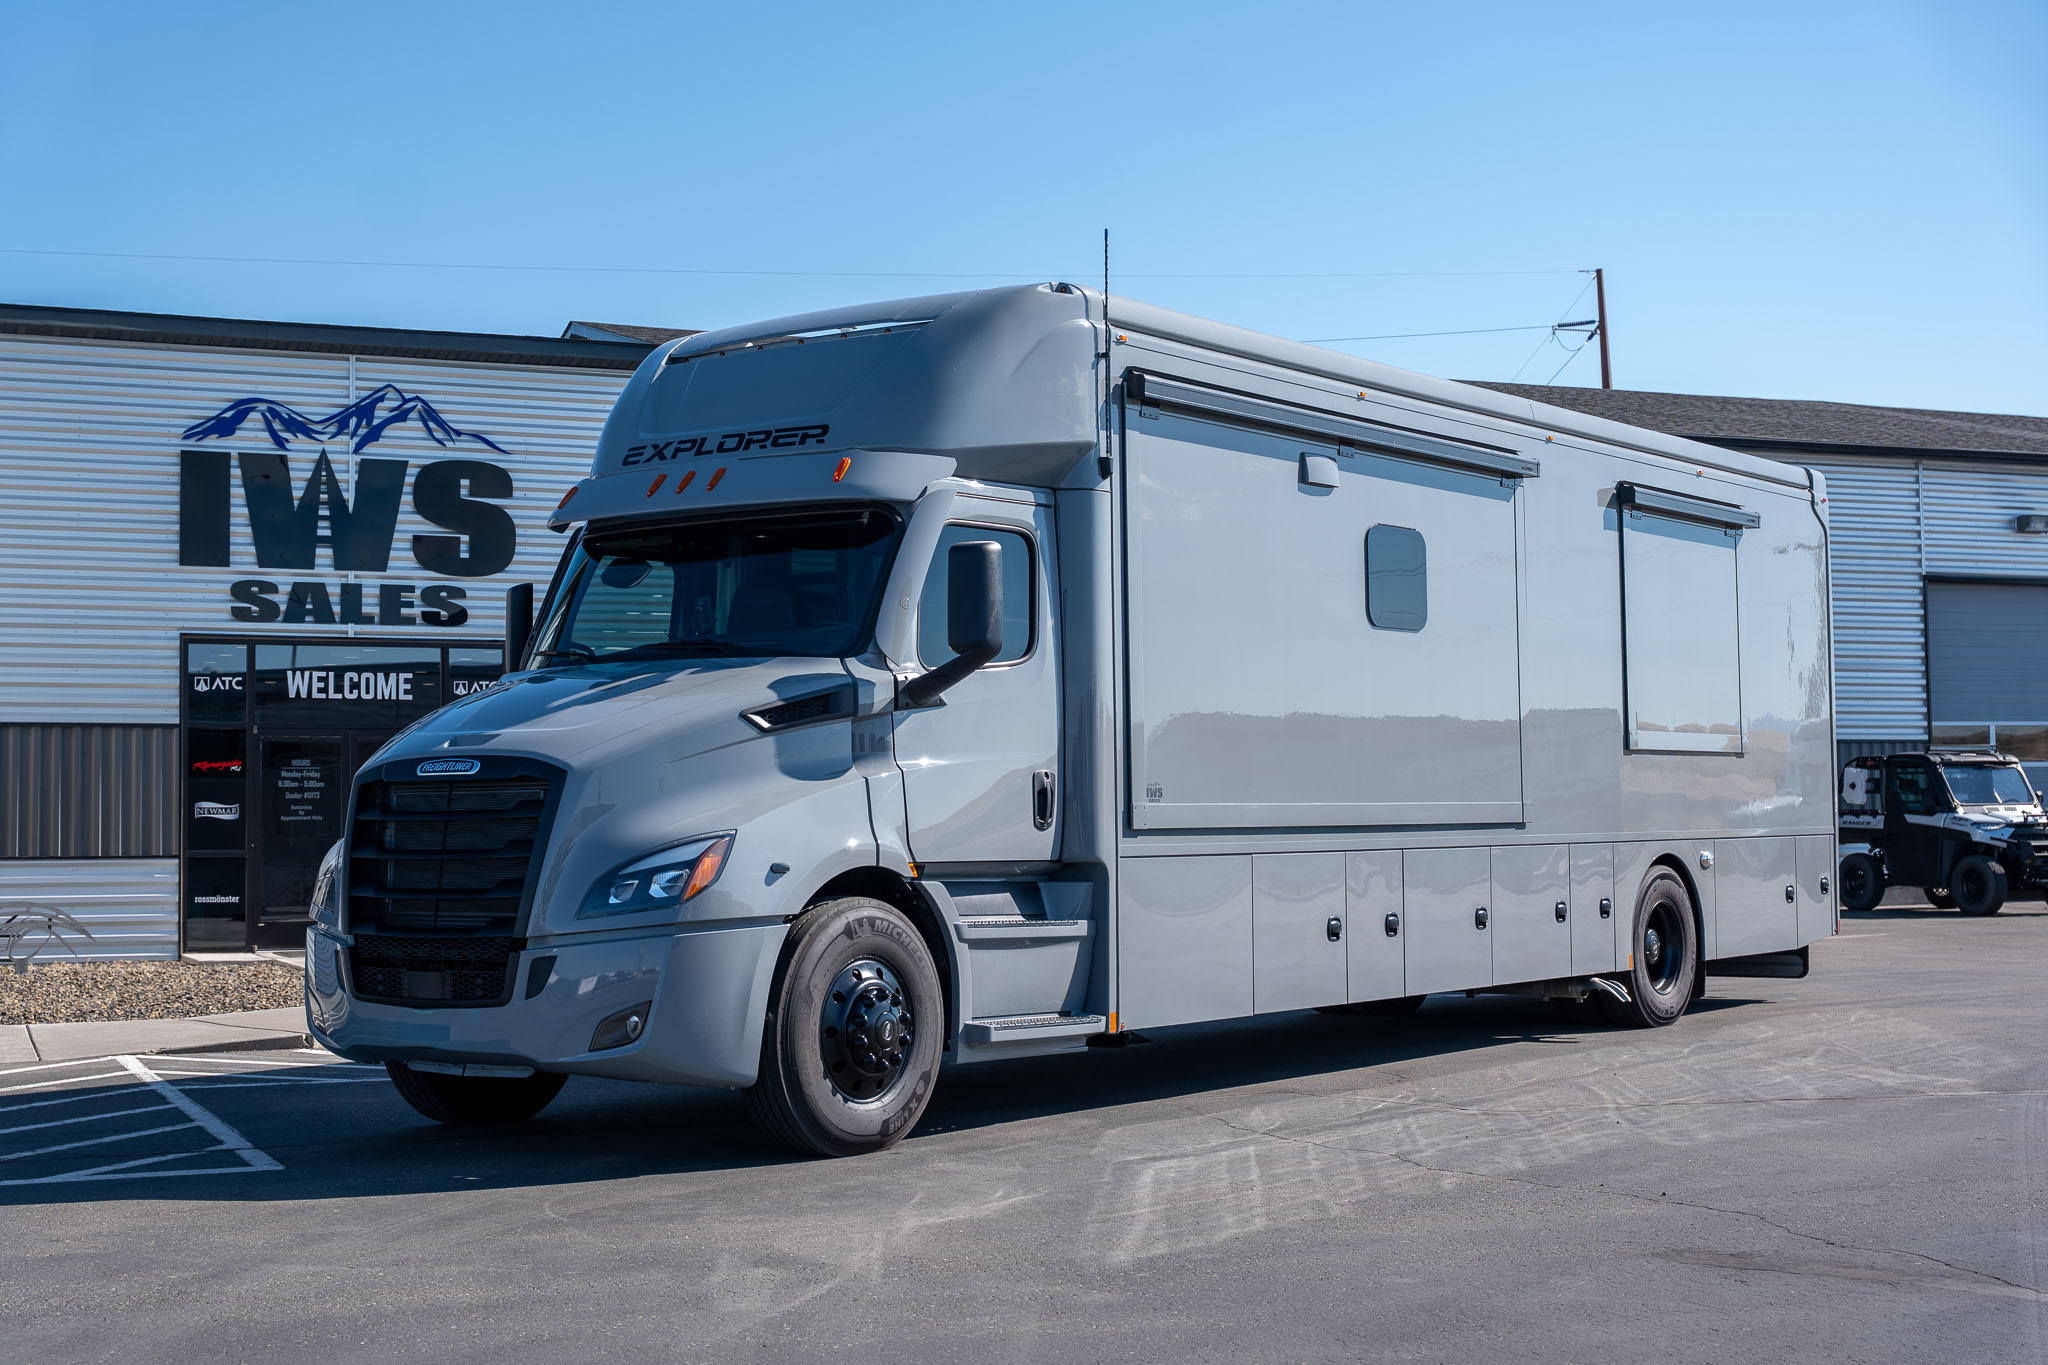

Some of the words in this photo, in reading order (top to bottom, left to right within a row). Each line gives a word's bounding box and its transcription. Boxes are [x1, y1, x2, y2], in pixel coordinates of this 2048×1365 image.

[622, 424, 830, 467] EXPLORER
[179, 447, 517, 577] IWS
[230, 580, 469, 627] SALES
[211, 677, 243, 690] ATC
[287, 670, 413, 700] WELCOME
[421, 762, 473, 772] FREIGHTLINER
[1146, 787, 1163, 798] IWS
[197, 807, 238, 815] NEWMAR
